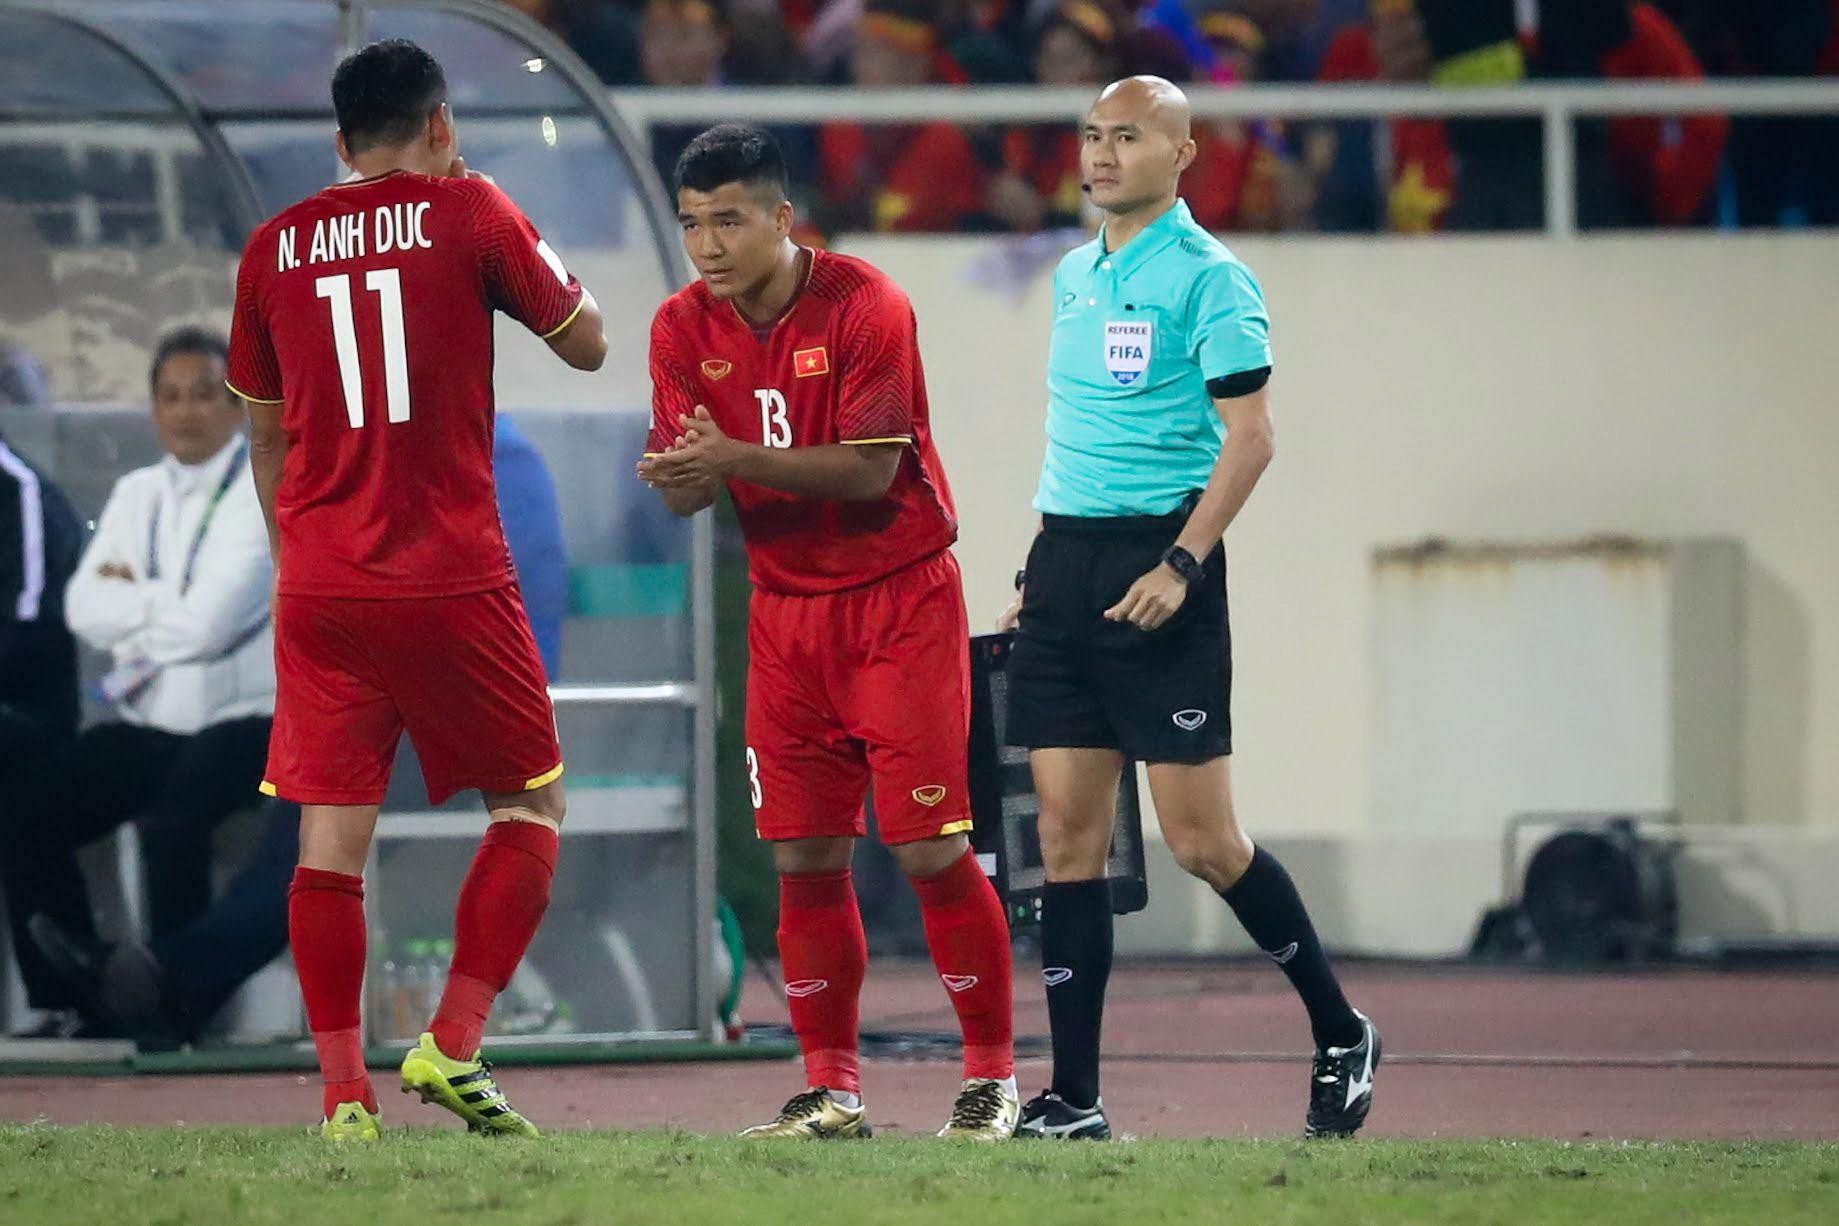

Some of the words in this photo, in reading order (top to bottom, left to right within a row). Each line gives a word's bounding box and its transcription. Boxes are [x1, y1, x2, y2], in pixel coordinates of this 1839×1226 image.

[278, 226, 300, 272] N.
[309, 211, 365, 264] ANH
[375, 201, 432, 254] DUC
[315, 268, 410, 428] 11
[1108, 326, 1148, 335] REFEREE
[1110, 346, 1143, 359] FIFA
[754, 388, 792, 448] 13
